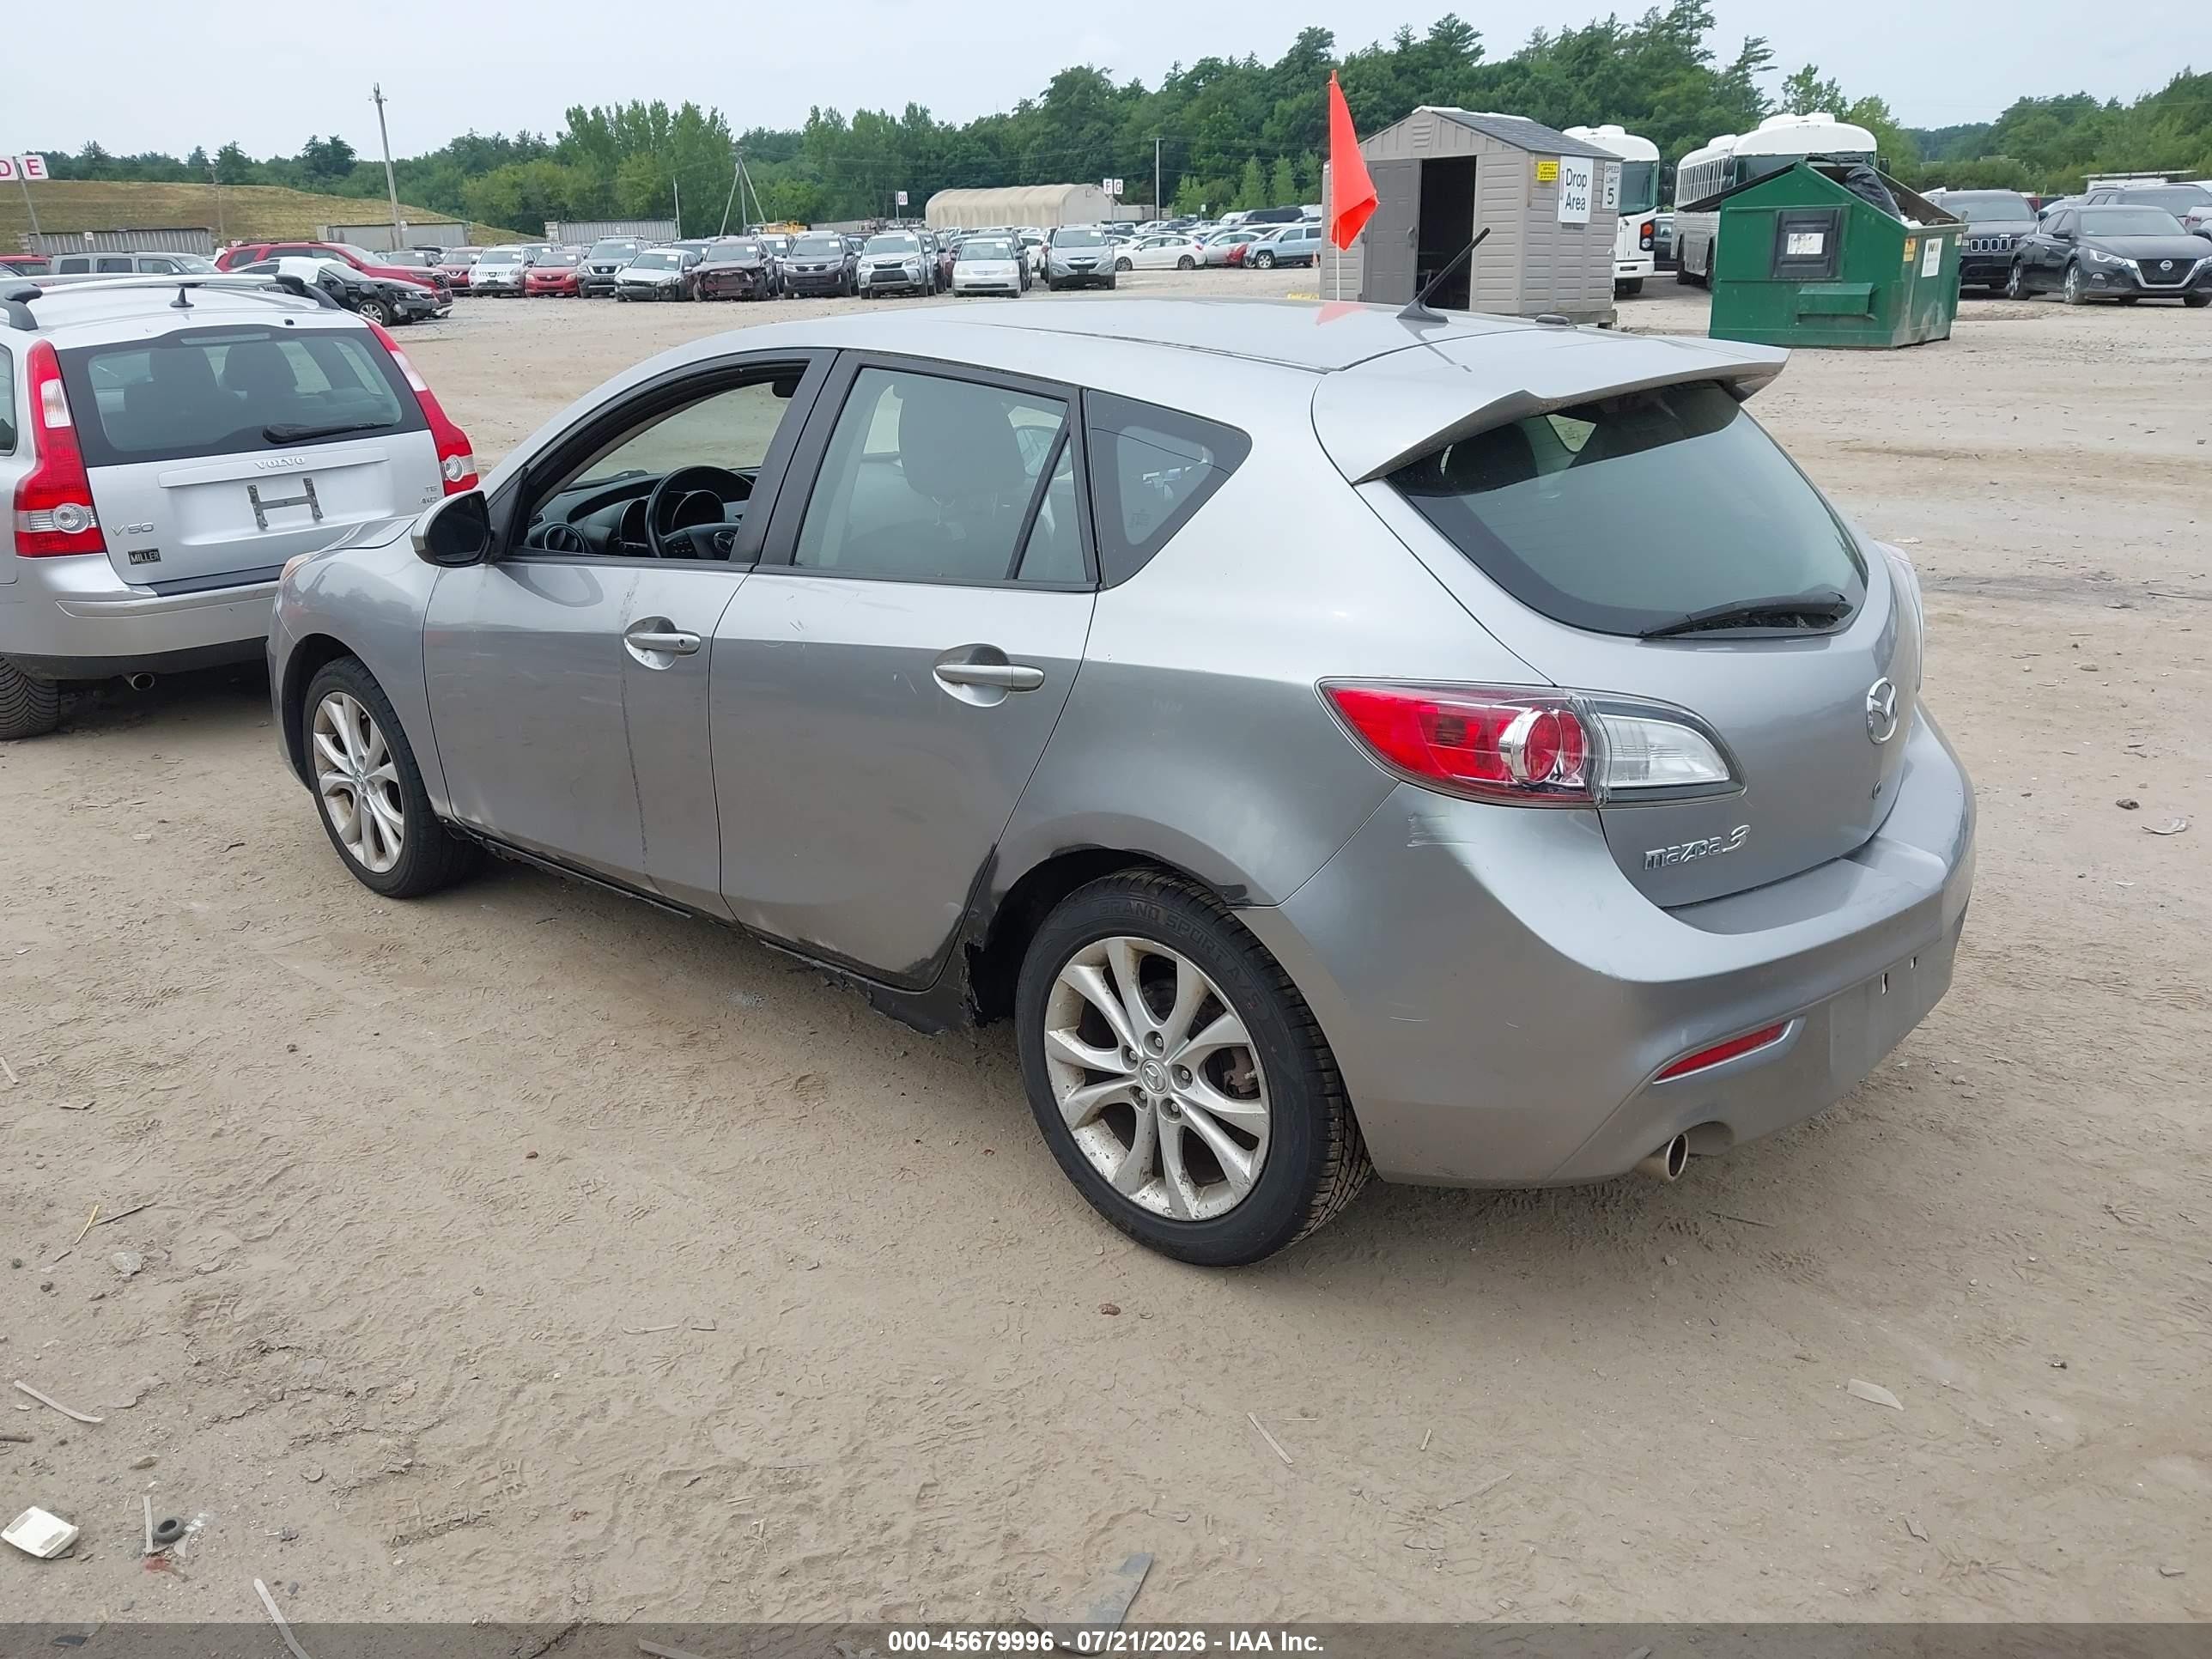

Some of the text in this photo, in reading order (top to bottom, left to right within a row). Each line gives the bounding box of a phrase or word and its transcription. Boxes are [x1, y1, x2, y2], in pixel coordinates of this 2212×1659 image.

[26, 159, 42, 175] E
[1565, 167, 1588, 191] Drop
[1105, 181, 1111, 192] F
[1115, 181, 1121, 192] G
[899, 194, 907, 203] 20
[1565, 191, 1586, 210] Area
[1607, 187, 1614, 205] 5
[254, 457, 305, 470] VOLVO
[131, 551, 160, 563] MILLER
[1165, 913, 1229, 963] SPORT
